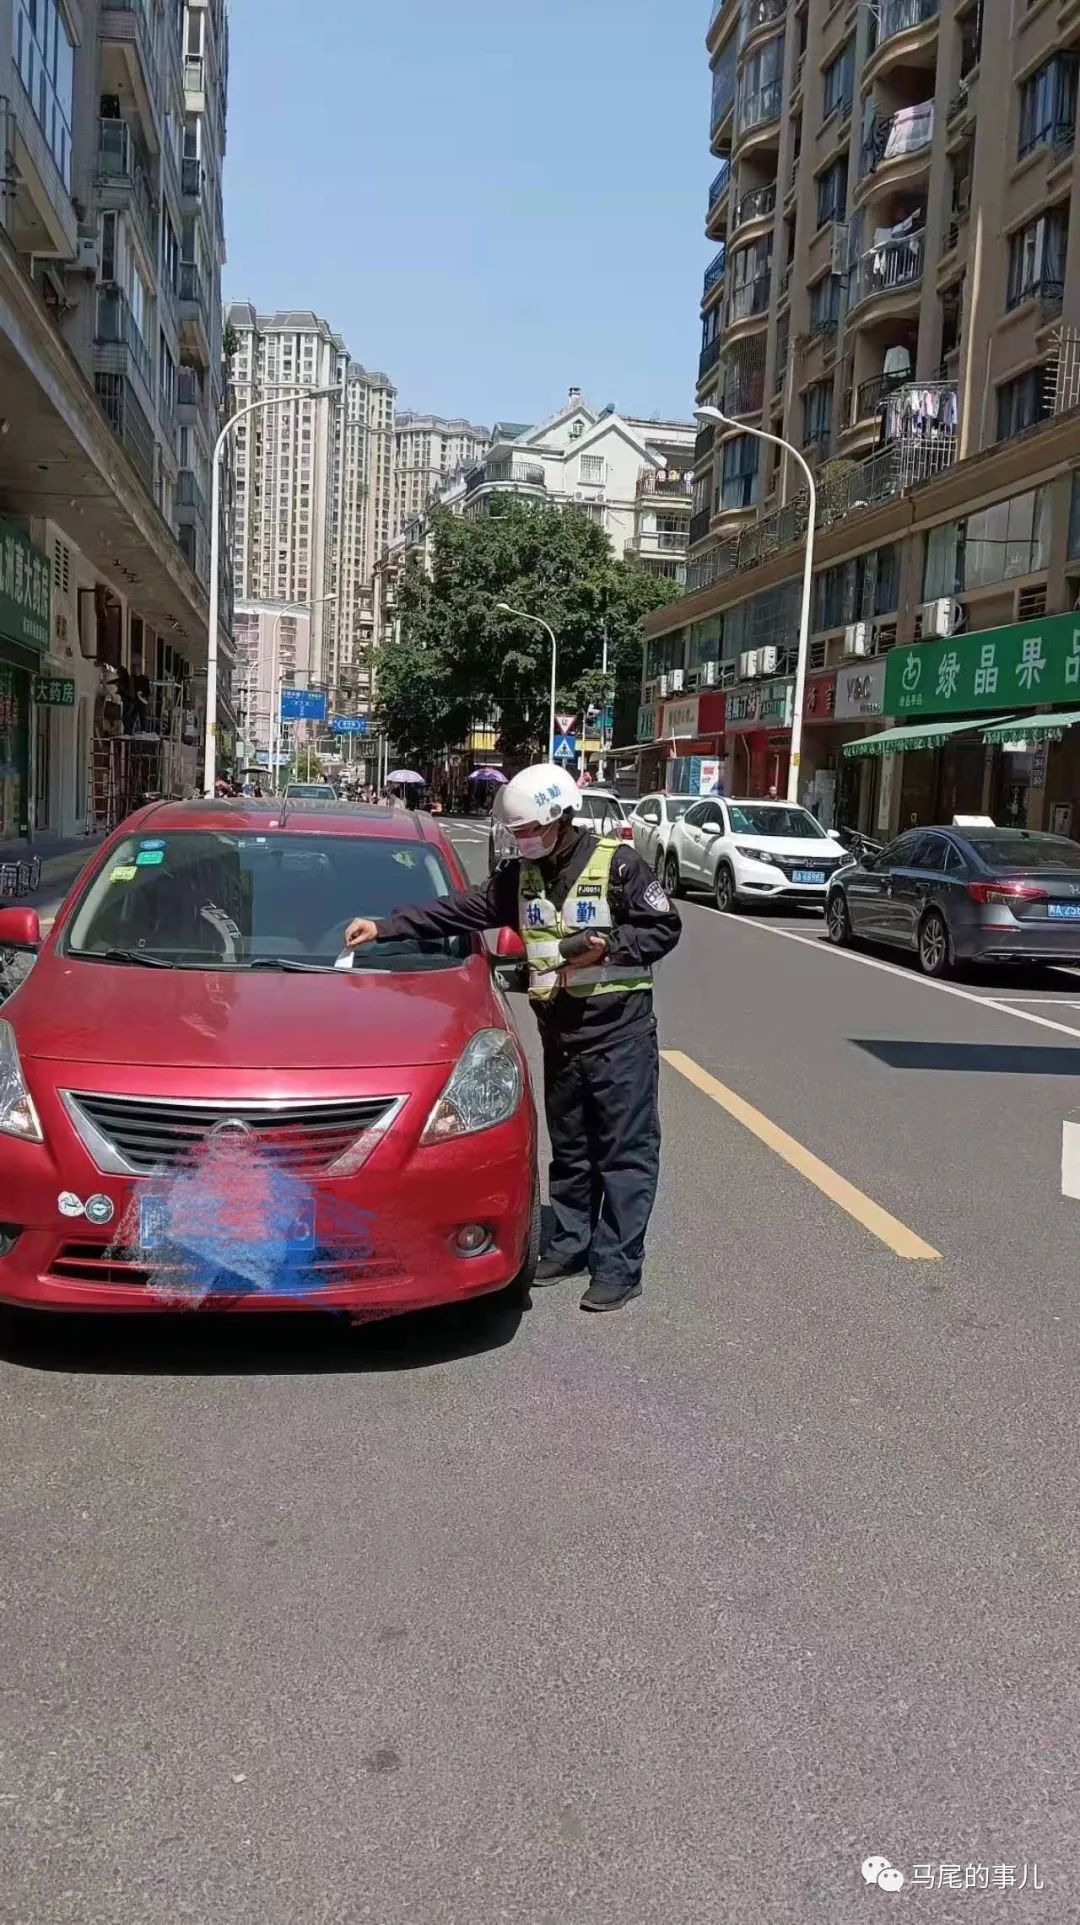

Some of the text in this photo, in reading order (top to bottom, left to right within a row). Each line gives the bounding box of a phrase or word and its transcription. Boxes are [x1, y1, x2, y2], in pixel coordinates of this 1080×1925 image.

[36, 680, 73, 703] 大药房
[534, 784, 561, 807] 执勤
